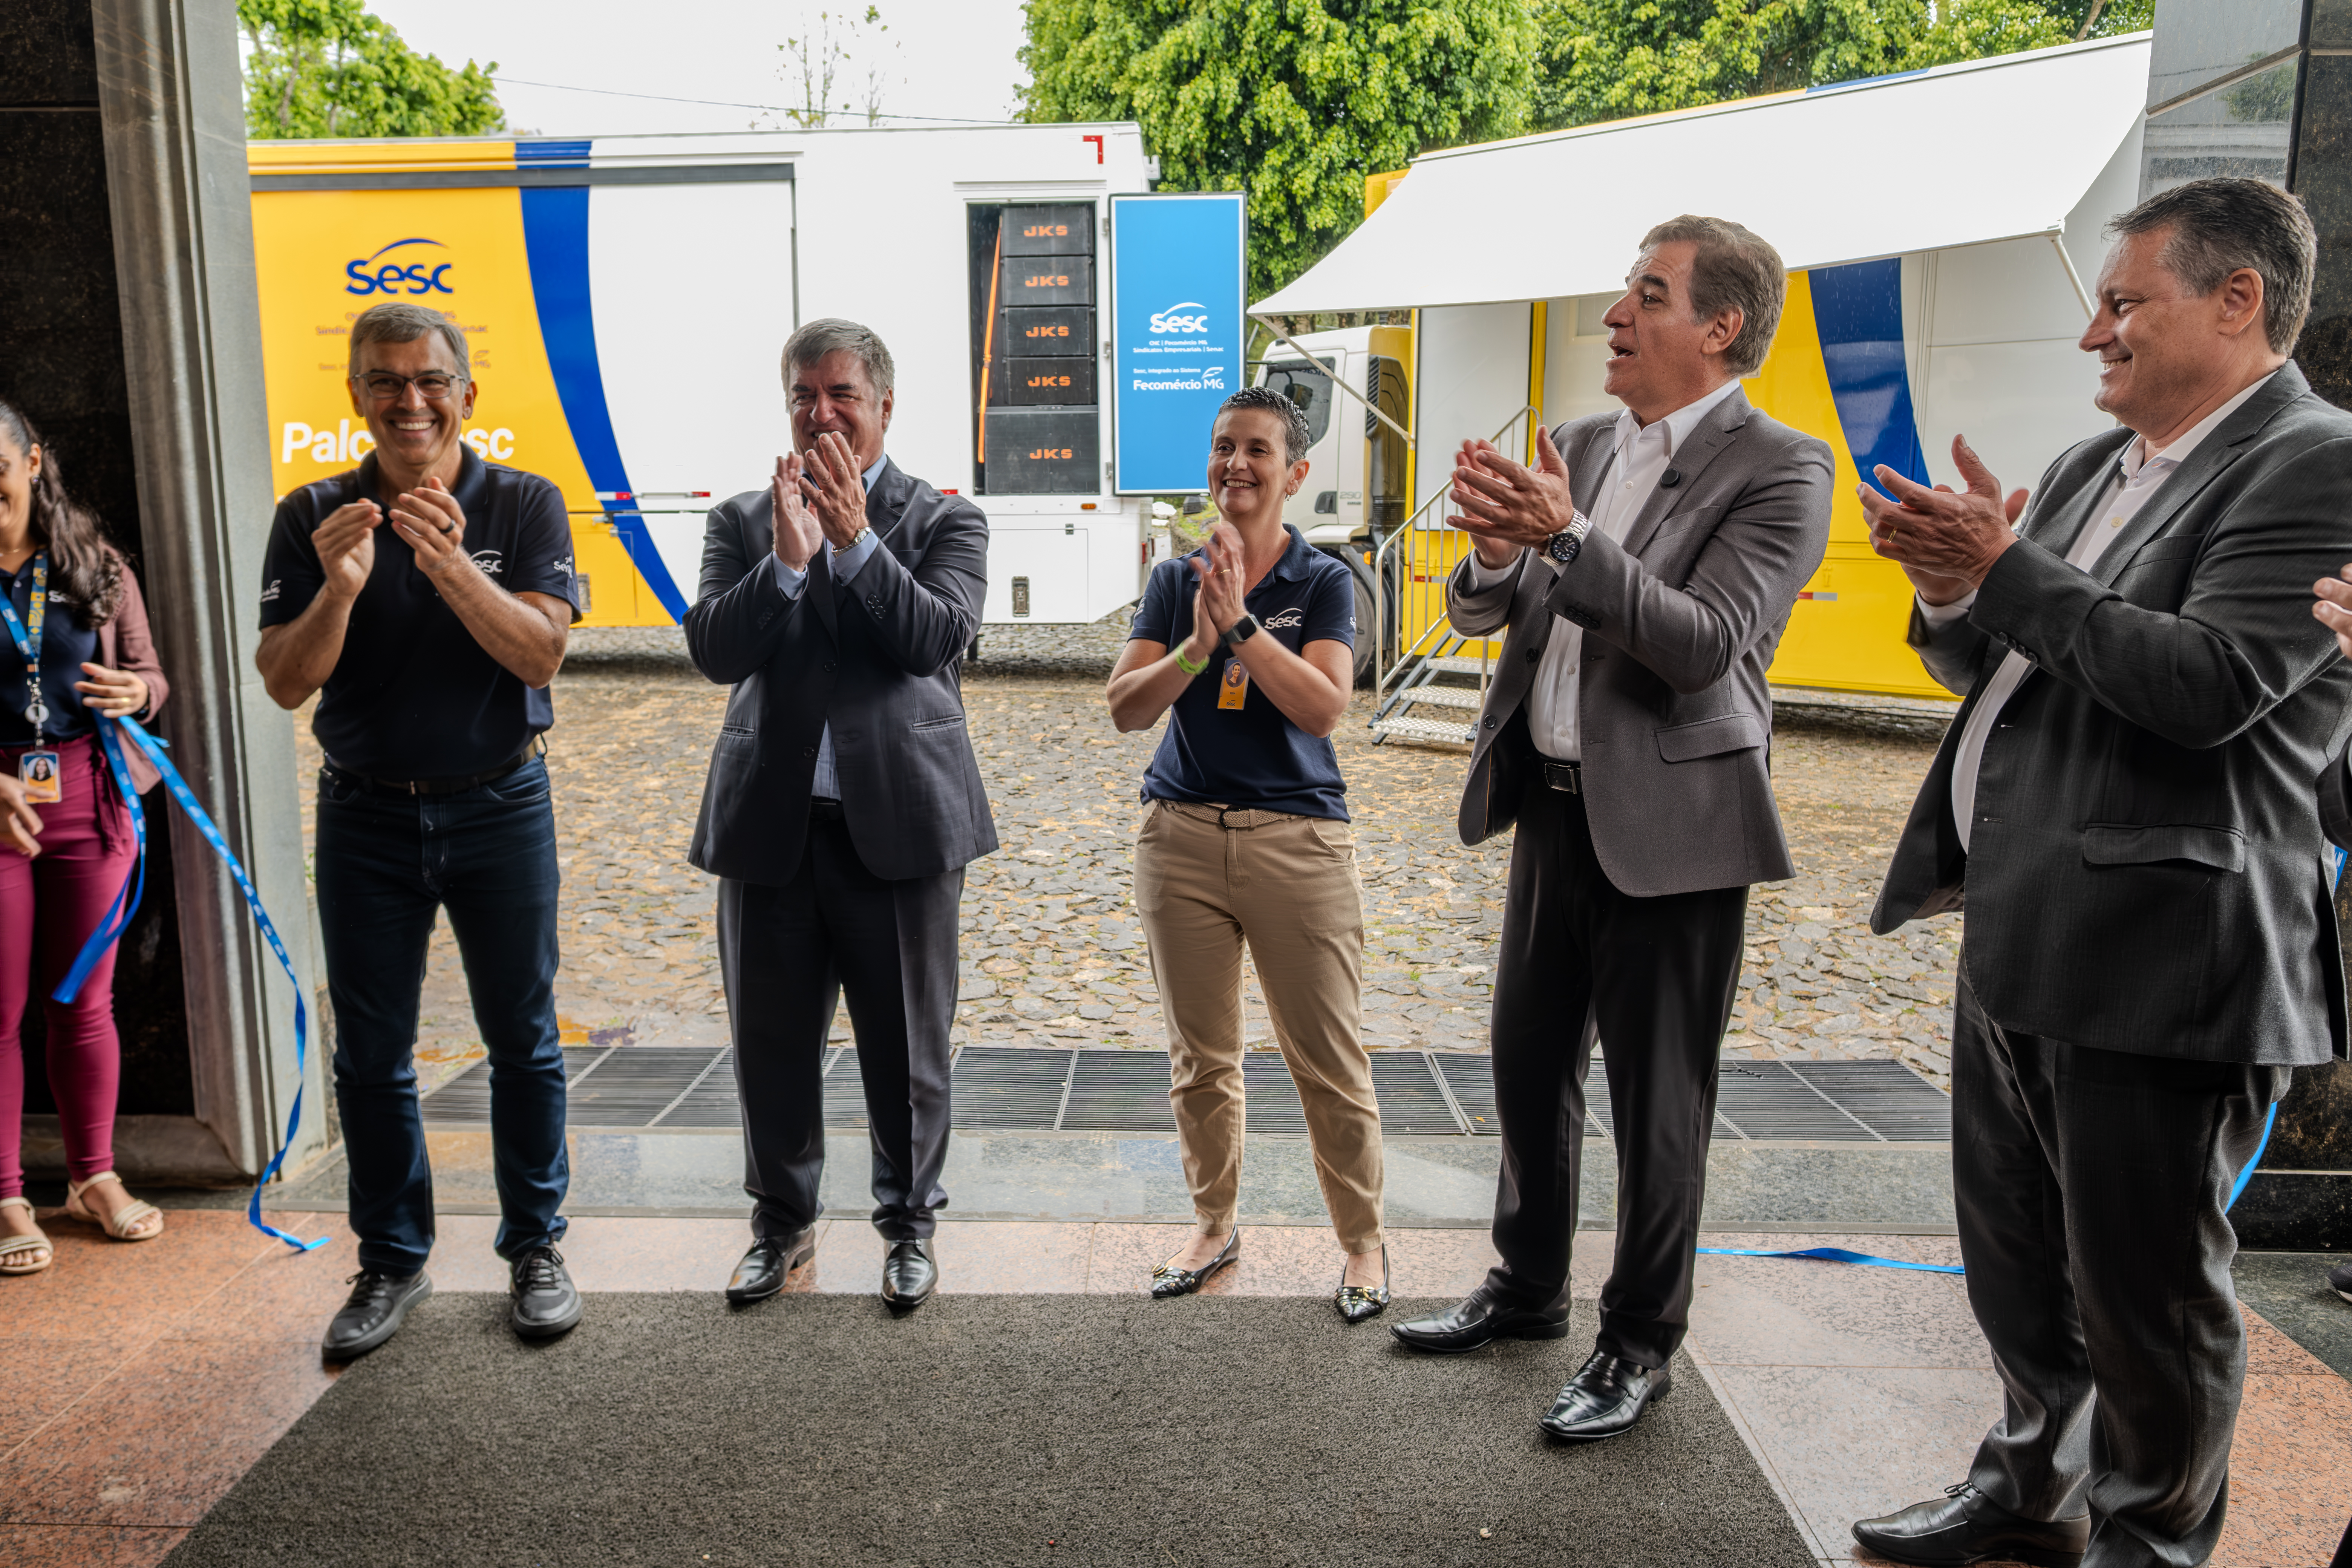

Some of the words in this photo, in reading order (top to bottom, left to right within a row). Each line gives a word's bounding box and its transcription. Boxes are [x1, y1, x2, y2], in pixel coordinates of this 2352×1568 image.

[1024, 225, 1068, 237] JKS
[345, 259, 454, 295] Sesc
[1025, 276, 1069, 287] JKS
[1149, 312, 1208, 333] Sesc
[1026, 326, 1069, 337] JKS
[1027, 376, 1070, 387] JKS
[1133, 379, 1202, 390] Fecomércio
[1204, 378, 1224, 389] MG
[282, 418, 375, 463] Palc
[459, 428, 514, 460] sc
[1029, 449, 1072, 459] JKS
[472, 559, 502, 573] esc
[1264, 615, 1302, 629] Sesc
